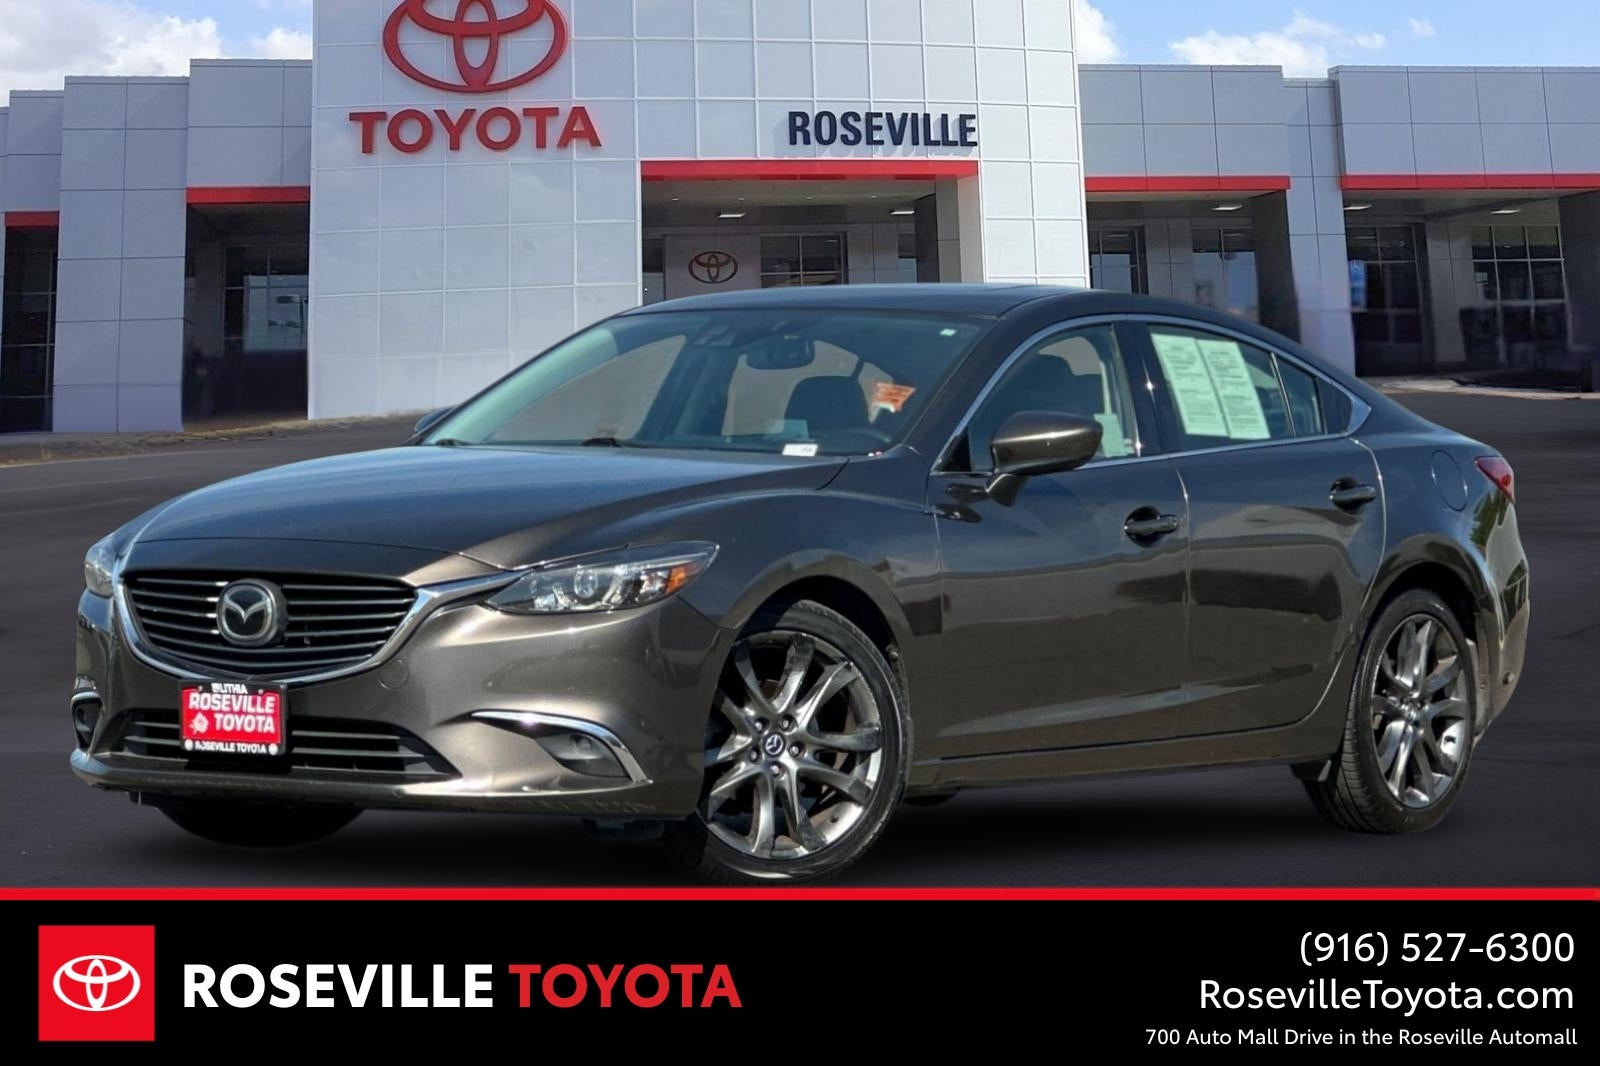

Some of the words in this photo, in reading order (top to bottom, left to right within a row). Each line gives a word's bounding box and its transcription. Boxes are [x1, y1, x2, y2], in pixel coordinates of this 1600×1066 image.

[349, 106, 602, 154] TOYOTA
[788, 110, 979, 147] ROSEVILLE
[188, 693, 276, 714] ROSEVILLE
[213, 713, 276, 734] TOYOTA
